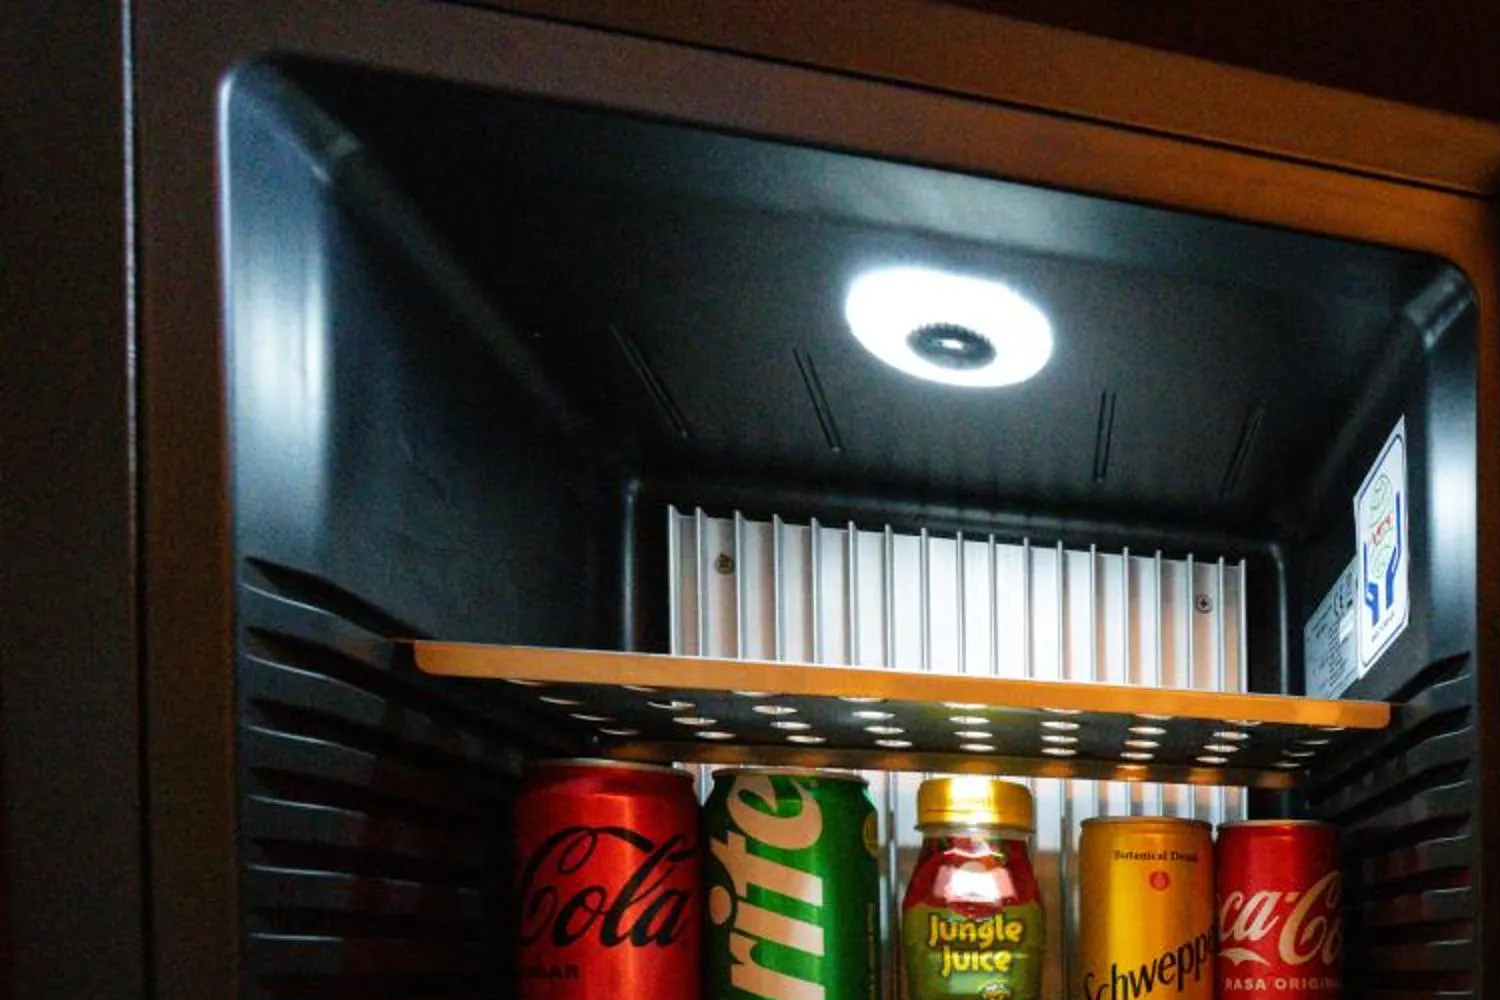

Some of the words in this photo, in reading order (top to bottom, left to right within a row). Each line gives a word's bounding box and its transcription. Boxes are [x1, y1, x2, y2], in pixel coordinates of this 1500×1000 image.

[517, 826, 695, 948] Cola
[928, 914, 1024, 949] Jungle
[1216, 869, 1344, 966] ca-Co
[941, 945, 1013, 977] Juice
[1224, 977, 1267, 991] RASA
[1275, 977, 1341, 991] ORIGIN
